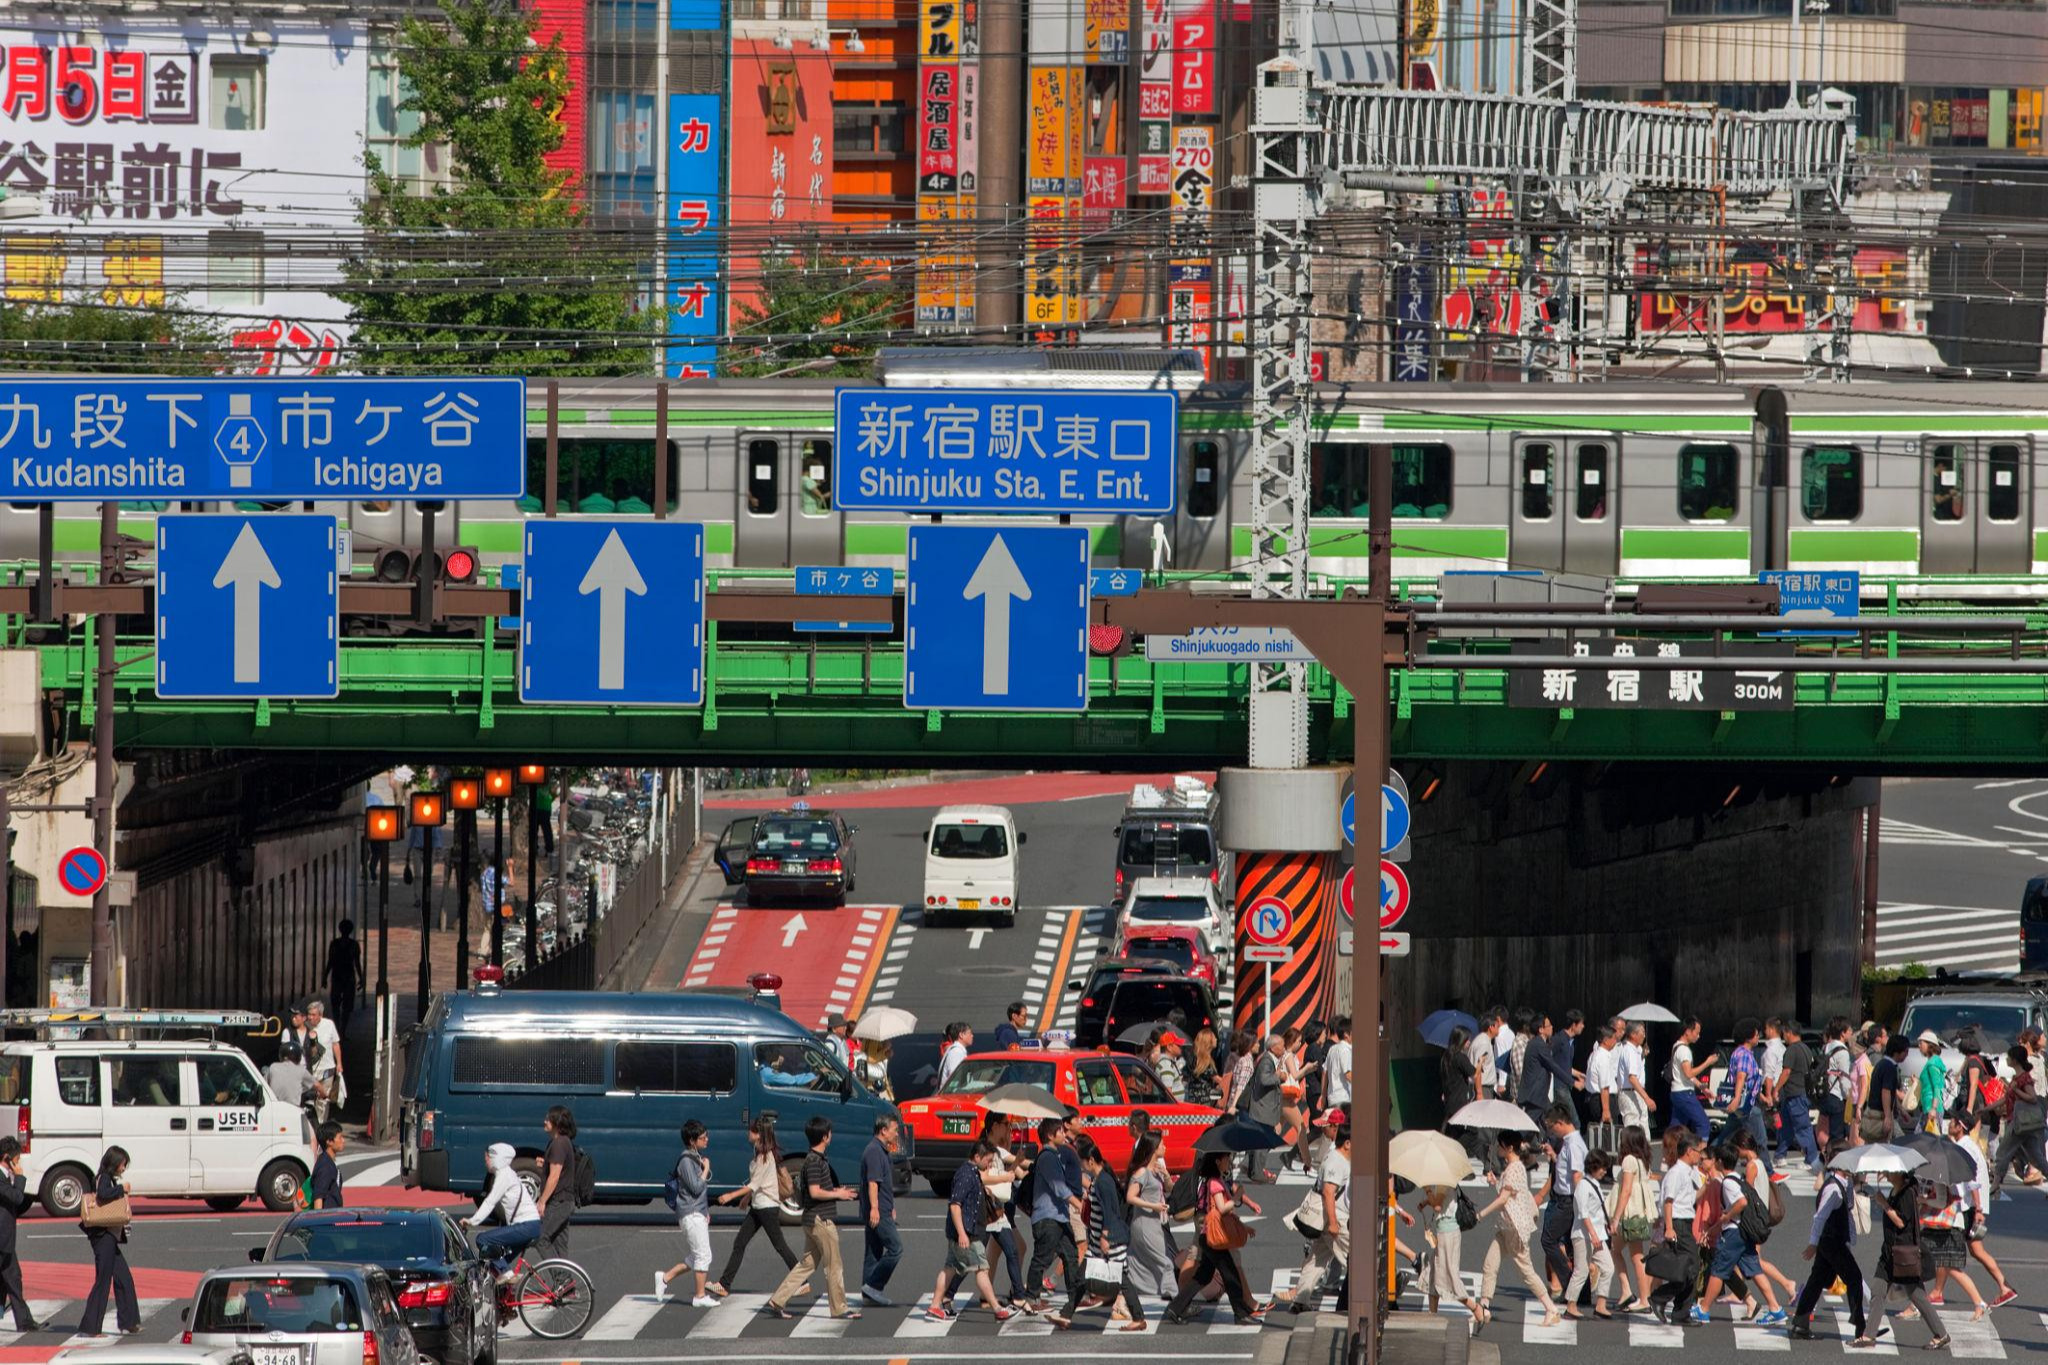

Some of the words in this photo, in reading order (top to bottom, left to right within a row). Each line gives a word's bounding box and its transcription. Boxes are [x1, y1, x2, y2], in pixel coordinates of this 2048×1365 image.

[1183, 25, 1204, 89] アコム
[154, 60, 187, 108] 金
[926, 71, 952, 151] 居酒屋
[1141, 88, 1169, 114] たばこ
[1183, 94, 1202, 107] 3F
[1148, 125, 1162, 151] 酒
[1175, 146, 1211, 167] 270
[928, 174, 949, 189] 4F
[1182, 266, 1201, 280] 2F
[1036, 302, 1055, 319] 6F
[0, 394, 203, 449] 九段下
[857, 401, 1151, 461] 新宿駅東口
[230, 426, 251, 456] 4
[13, 457, 185, 488] Kudanshita
[314, 456, 443, 491] Ichigaya
[859, 466, 981, 503] Shinjuku
[994, 468, 1046, 500] Sta.
[1060, 470, 1084, 501] E.
[1097, 470, 1149, 501] Ent.
[1781, 595, 1820, 606] hinjuku
[1824, 594, 1845, 604] STN
[1171, 639, 1260, 656] Shinjukuogado
[1265, 640, 1293, 652] nishi
[1542, 670, 1704, 702] 新宿駅
[1734, 684, 1783, 700] 300M
[219, 1112, 258, 1125] USEN
